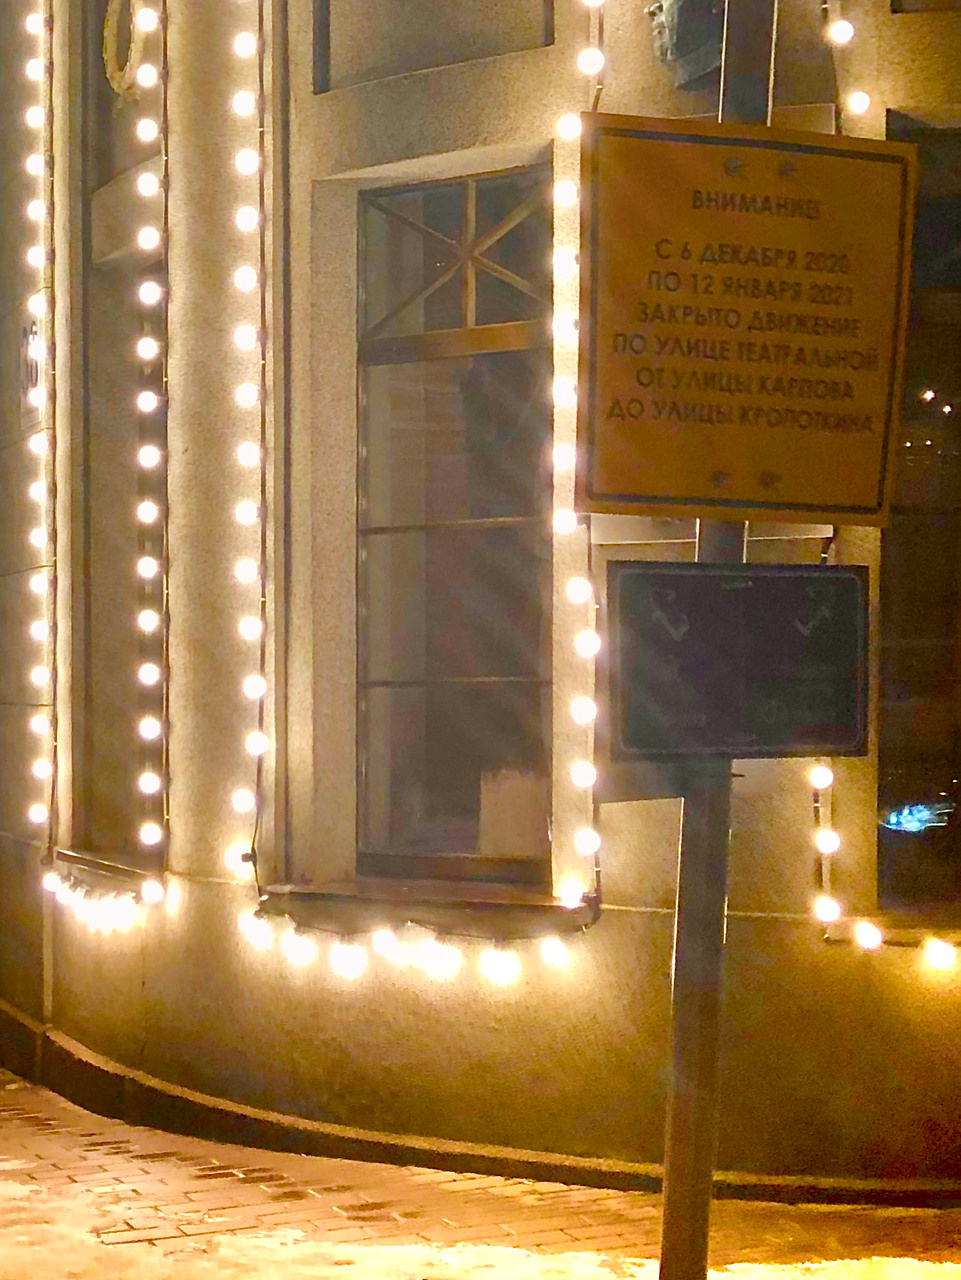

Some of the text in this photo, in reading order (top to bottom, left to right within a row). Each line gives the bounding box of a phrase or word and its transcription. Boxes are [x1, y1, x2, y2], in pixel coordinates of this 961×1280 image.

[655, 238, 672, 260] С
[681, 242, 691, 261] 6
[699, 243, 797, 267] ДЕКАБРЯ
[647, 271, 682, 293] ПО
[690, 275, 714, 295] 12
[721, 277, 803, 300] ЯНВАРЯ
[638, 302, 862, 340] ЗАКРЫТО ДВИЖЕНИЕ
[612, 333, 880, 373] ПО УЛИЦЕ ТЕАТРАЛЬНОЙ
[635, 367, 855, 402] ОТ УЛИЦЫ КАРПОВА
[606, 397, 645, 420] ДО
[652, 402, 733, 426] УЛИЦЫ
